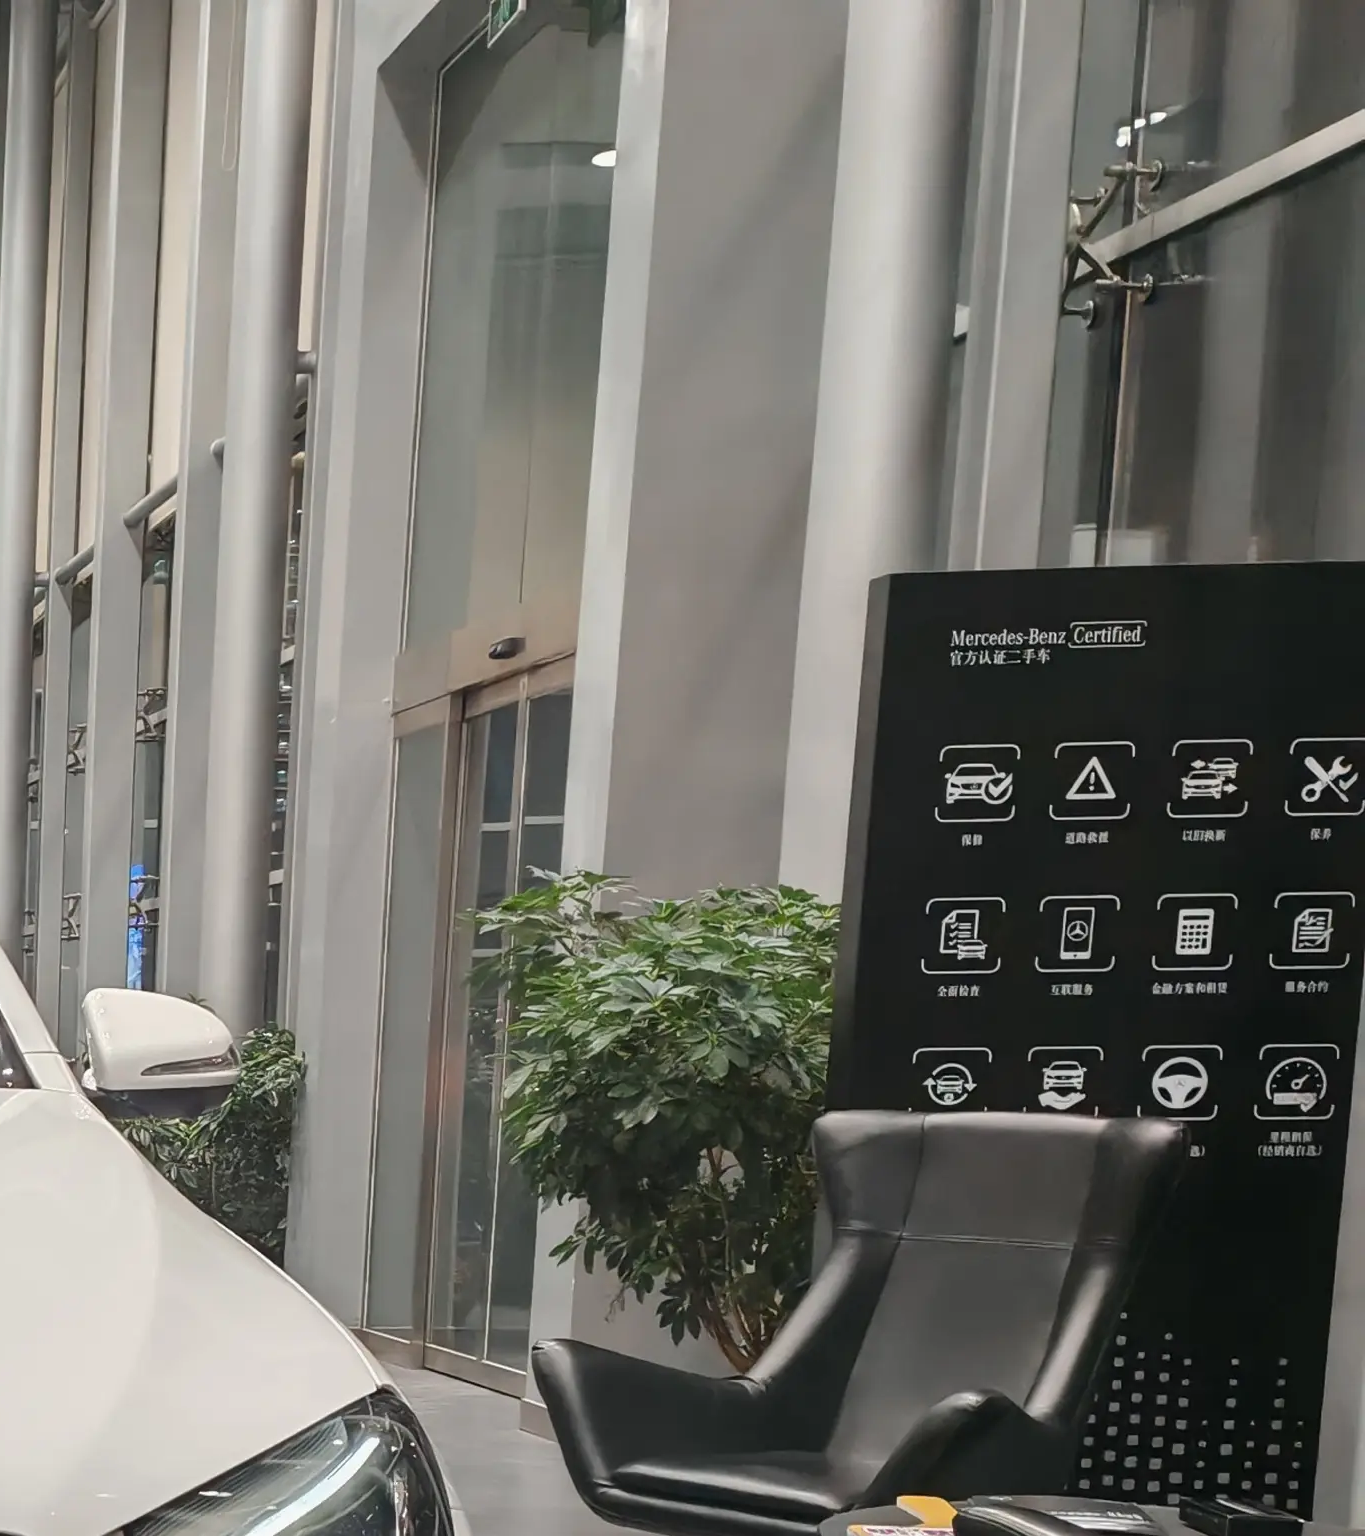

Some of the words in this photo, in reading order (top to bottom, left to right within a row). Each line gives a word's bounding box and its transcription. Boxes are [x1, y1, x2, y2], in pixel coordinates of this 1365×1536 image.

[950, 627, 1067, 647] Mercedes-Benz
[1073, 625, 1144, 645] Certified
[950, 647, 1051, 667] 官方认证二手车
